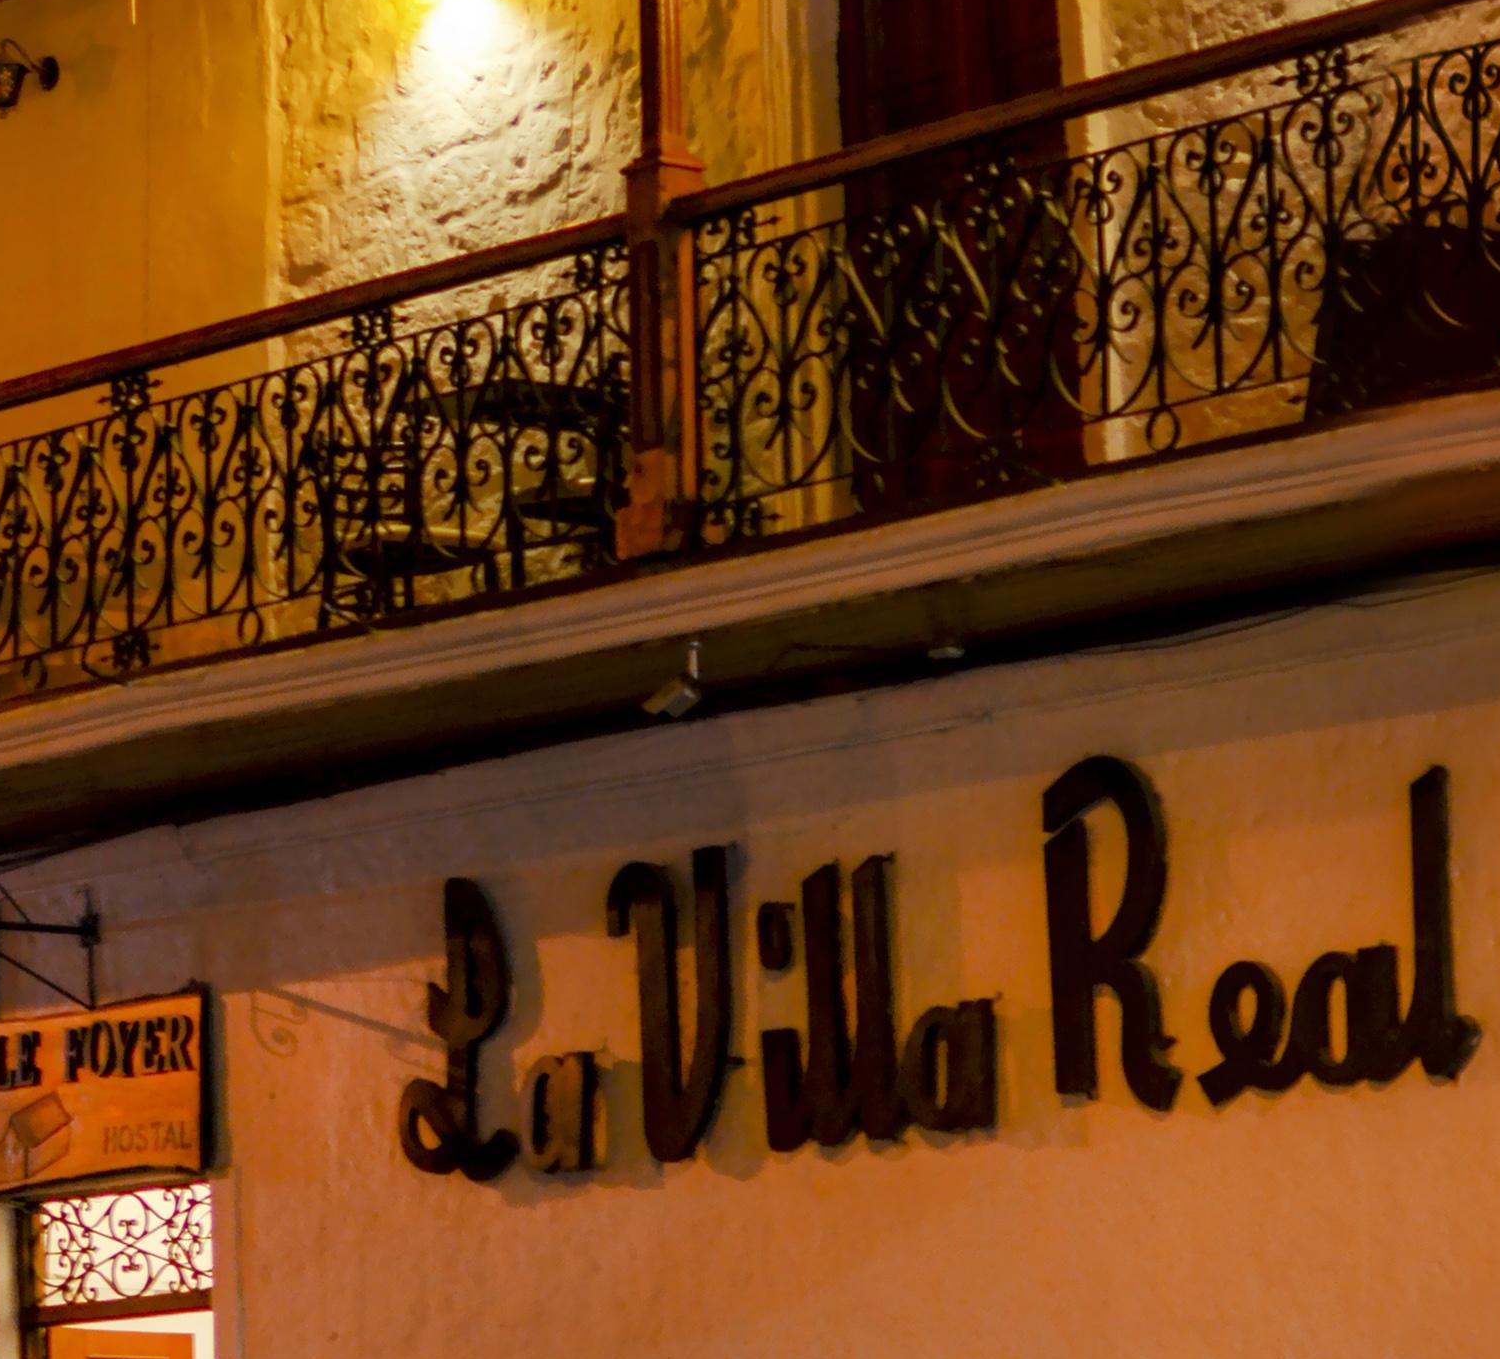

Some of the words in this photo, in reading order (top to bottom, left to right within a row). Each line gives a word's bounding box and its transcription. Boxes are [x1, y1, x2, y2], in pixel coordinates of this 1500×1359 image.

[399, 877, 607, 1180] La
[607, 845, 1003, 1163] Villa
[1041, 753, 1481, 1112] Real
[64, 1015, 196, 1083] FOYER
[101, 1121, 192, 1154] HOSTAL
